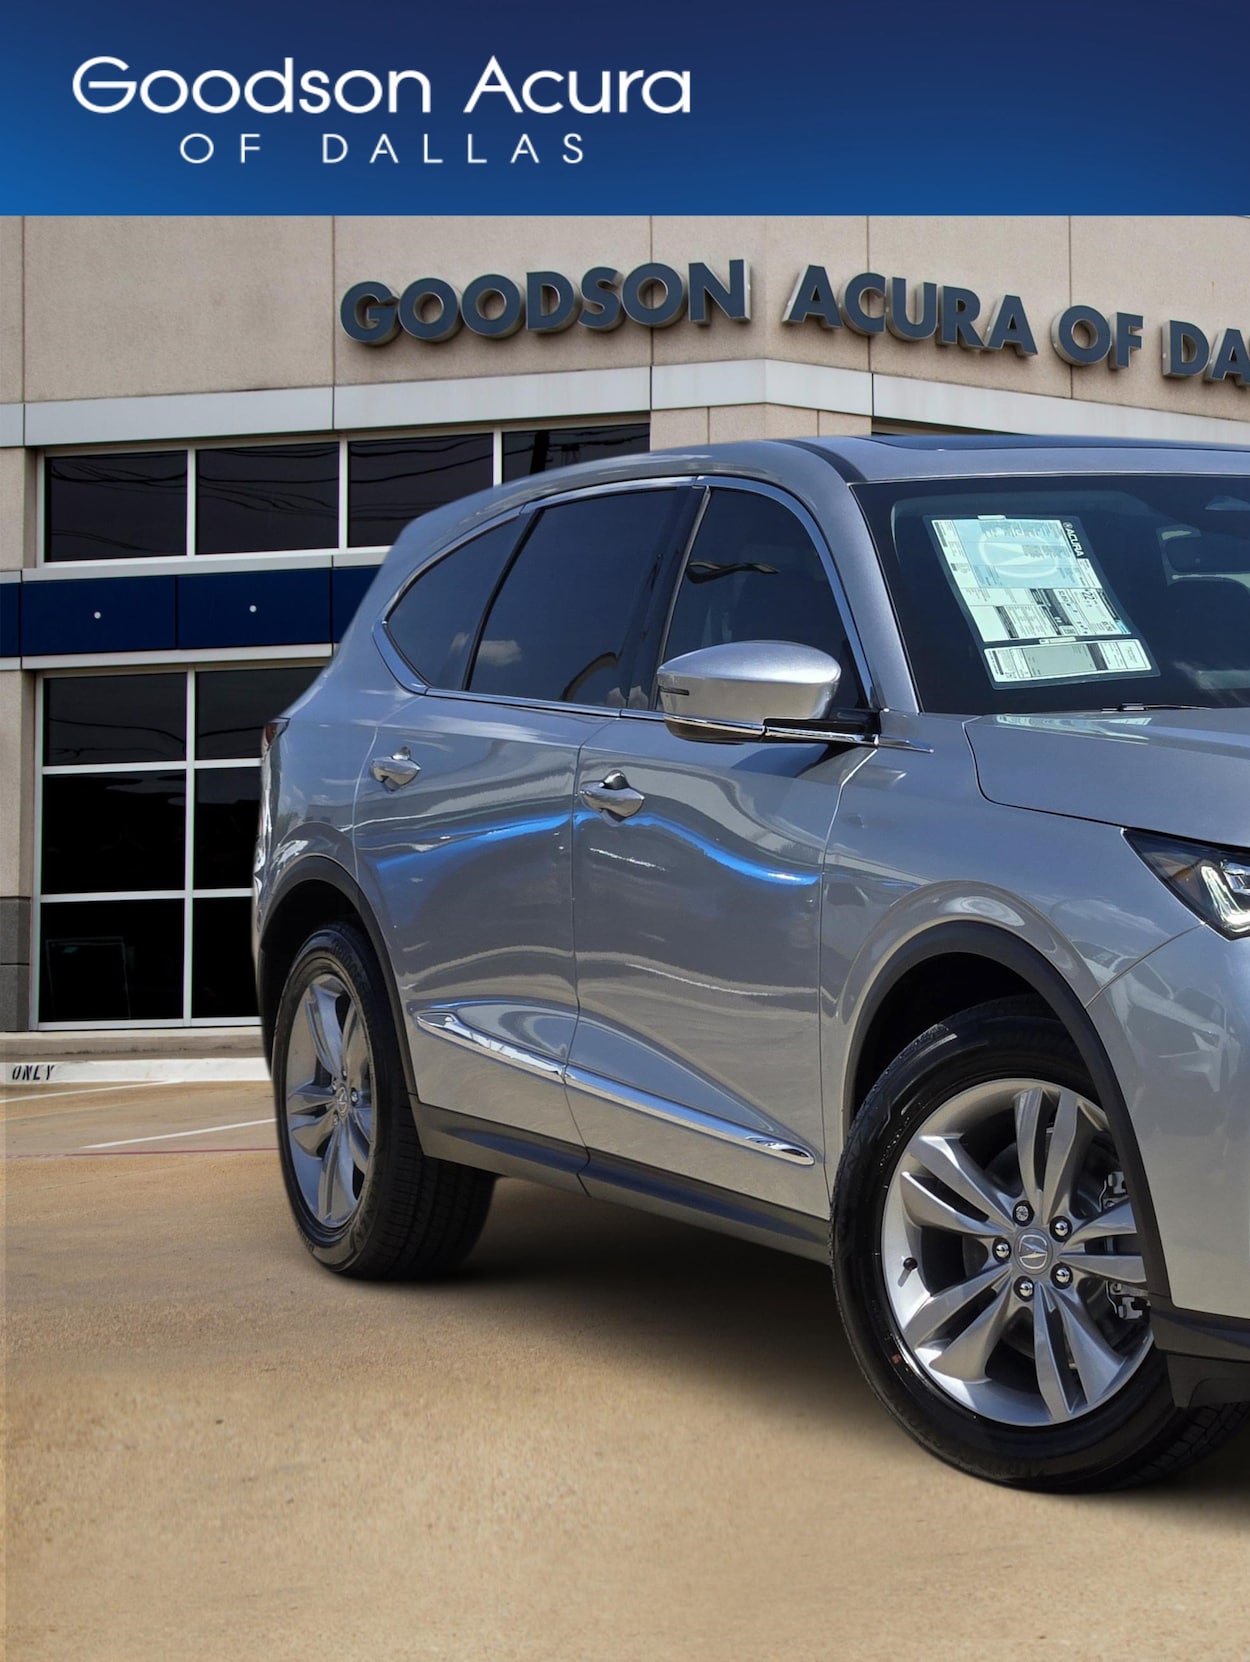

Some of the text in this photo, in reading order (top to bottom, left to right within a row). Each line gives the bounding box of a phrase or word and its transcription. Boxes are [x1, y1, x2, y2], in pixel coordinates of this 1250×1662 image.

[341, 259, 750, 346] GOODSON
[782, 265, 1038, 356] ACURA
[1051, 305, 1143, 370] OF
[1066, 528, 1084, 557] ACURA
[12, 1064, 55, 1081] ONLY
